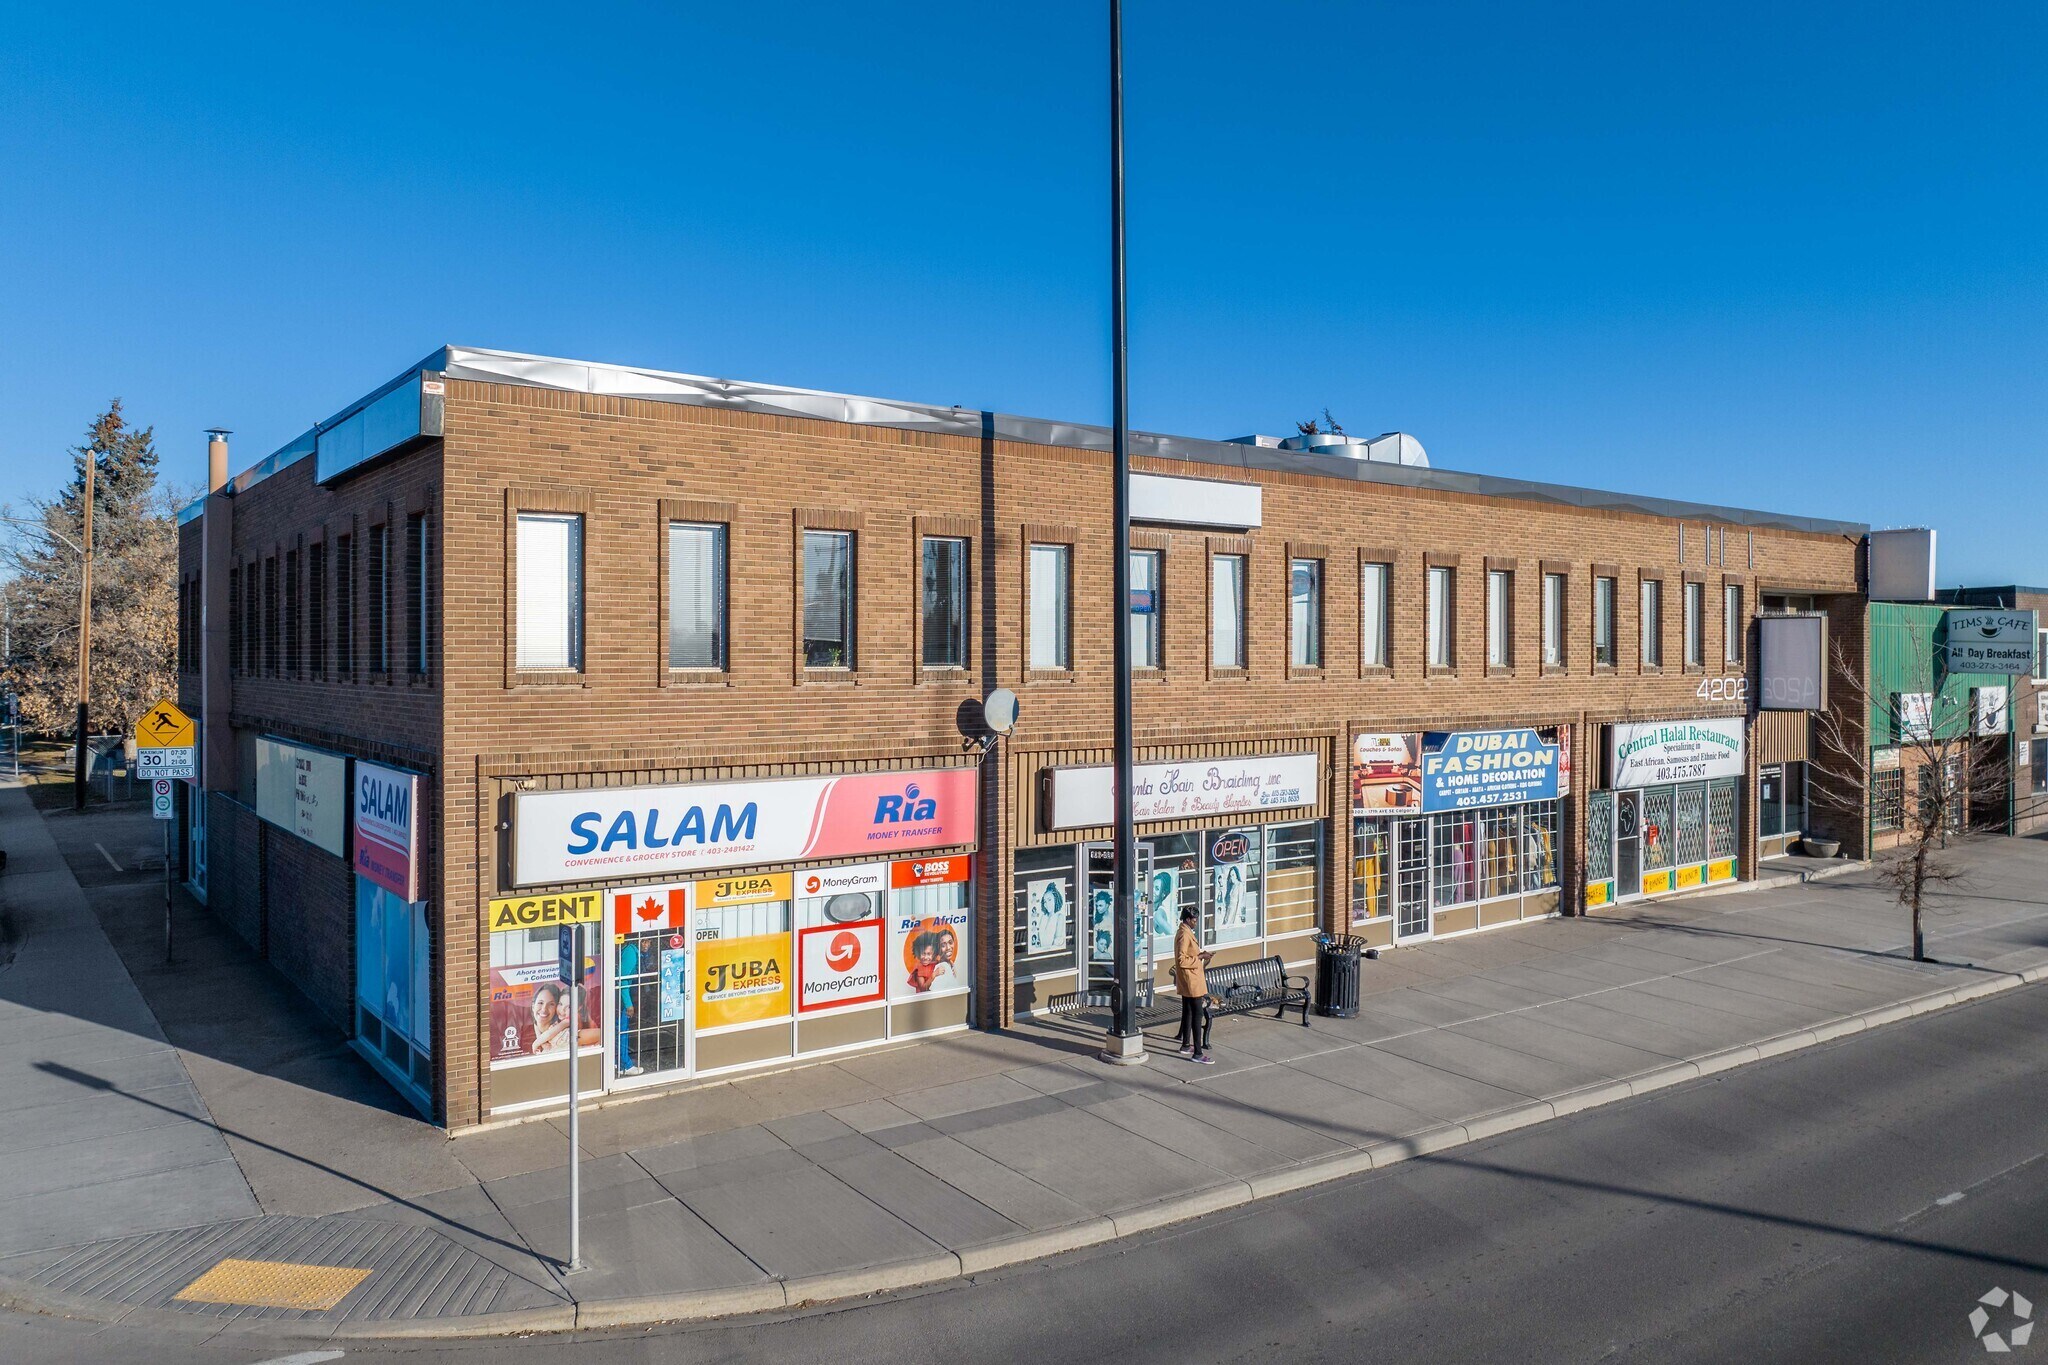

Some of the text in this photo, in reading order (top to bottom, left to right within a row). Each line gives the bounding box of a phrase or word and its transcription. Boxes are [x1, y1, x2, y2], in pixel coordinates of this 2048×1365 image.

[1952, 616, 2031, 631] TIMS CAFE
[1951, 648, 2031, 660] All Day Breakfast
[1696, 677, 1750, 701] 4202
[1456, 733, 1529, 753] DUBAI
[1618, 725, 1740, 760] Central Halal Restaurant
[1663, 741, 1701, 754] Specializing in
[143, 755, 162, 765] 30
[1427, 749, 1554, 775] FASHION
[1630, 758, 1643, 768] East
[1666, 755, 1689, 765] Samosas
[1689, 752, 1700, 761] and
[1700, 751, 1717, 761] Ethnic
[1718, 750, 1730, 760] Food
[1435, 777, 1445, 788] &
[1448, 773, 1479, 787] HOME
[1481, 768, 1546, 784] DECORATION
[1656, 763, 1707, 781] 403.475.7887
[1160, 769, 1194, 795] Hair
[1202, 767, 1260, 796] Braiding
[361, 775, 408, 828] SALAM
[873, 783, 937, 824] Ria
[1153, 799, 1175, 815] Salon
[1191, 796, 1220, 813] Beauty
[1223, 793, 1251, 812] Supplies
[1456, 791, 1528, 807] 403.457.2531
[567, 802, 758, 855] SALAM
[867, 826, 943, 840] MONEY TRANSFER
[564, 855, 624, 867] CONVENIENCE
[632, 852, 670, 862] GROCERY
[671, 849, 697, 858] STORE
[706, 844, 755, 855] 403-2481422
[1214, 839, 1248, 857] OPEN
[924, 861, 950, 872] BOSS
[715, 878, 772, 898] JUBA
[822, 874, 878, 888] MoneyGram
[736, 888, 773, 896] EXPRESS
[495, 896, 595, 927] AGENT
[901, 915, 967, 929] Ria Africa
[696, 930, 719, 941] OPEN
[704, 958, 781, 994] JUBA
[733, 975, 781, 991] EXPRESS
[804, 973, 878, 995] MoneyGram
[493, 989, 512, 1001] Ria
[707, 993, 727, 1001] SERVICE
[728, 990, 747, 998] BEYOND
